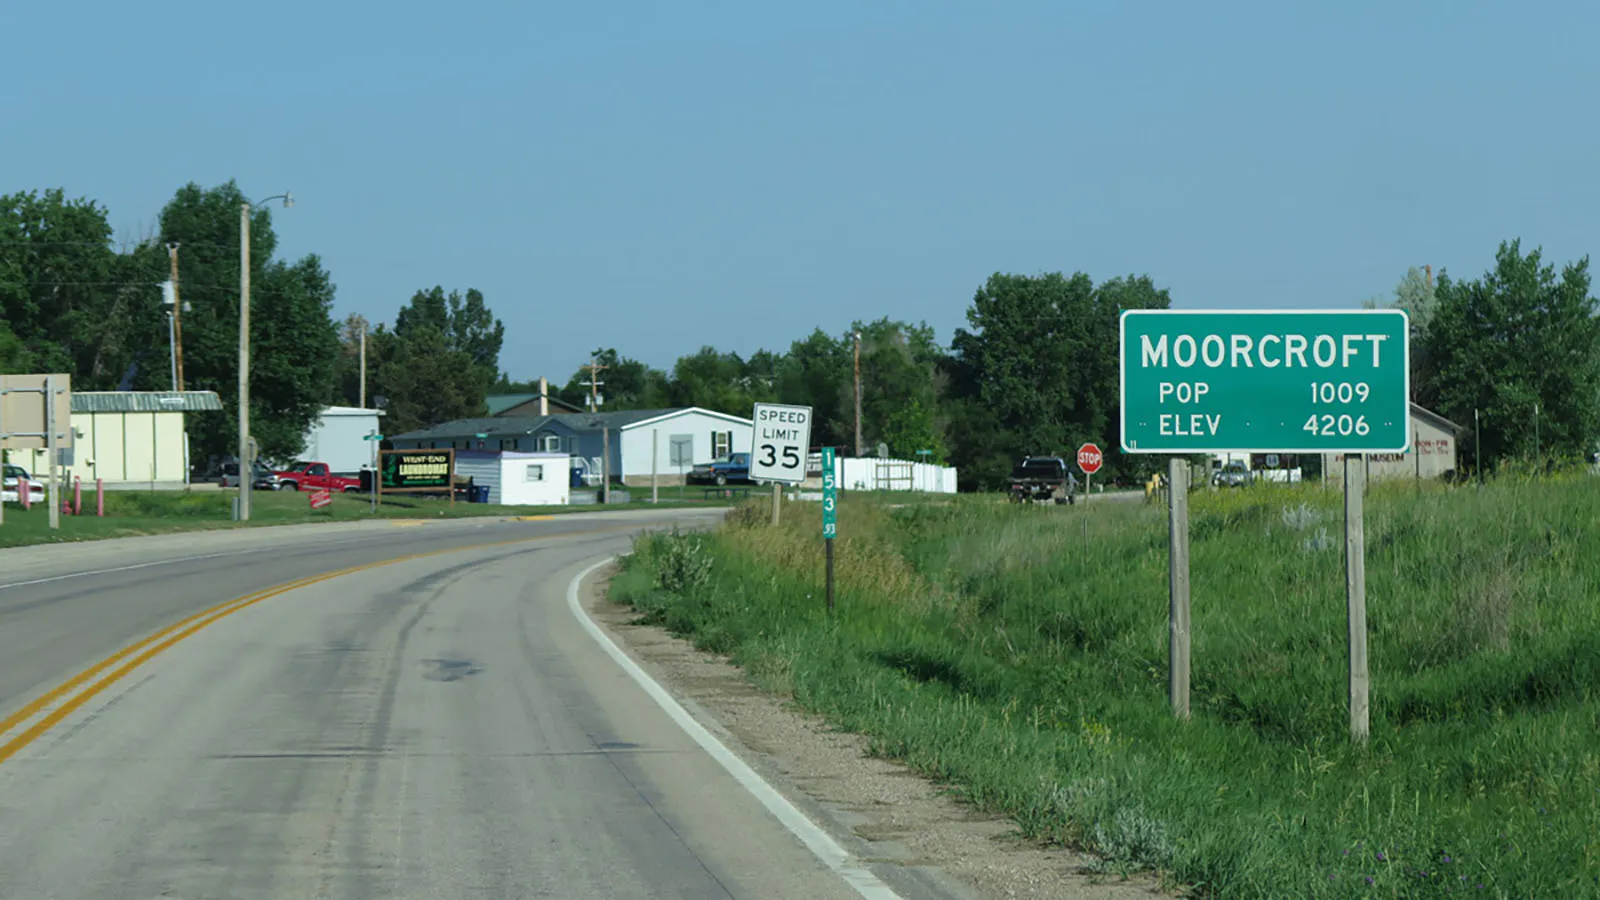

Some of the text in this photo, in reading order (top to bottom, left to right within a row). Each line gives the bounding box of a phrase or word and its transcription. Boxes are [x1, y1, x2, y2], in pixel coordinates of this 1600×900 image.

[1140, 333, 1388, 368] MOORCROFT
[1159, 382, 1371, 404] POP 1009
[759, 409, 806, 424] SPEED
[1159, 414, 1371, 436] ELEV 4206
[763, 427, 799, 441] LIMIT
[758, 444, 800, 469] 35
[1079, 451, 1100, 465] STOP
